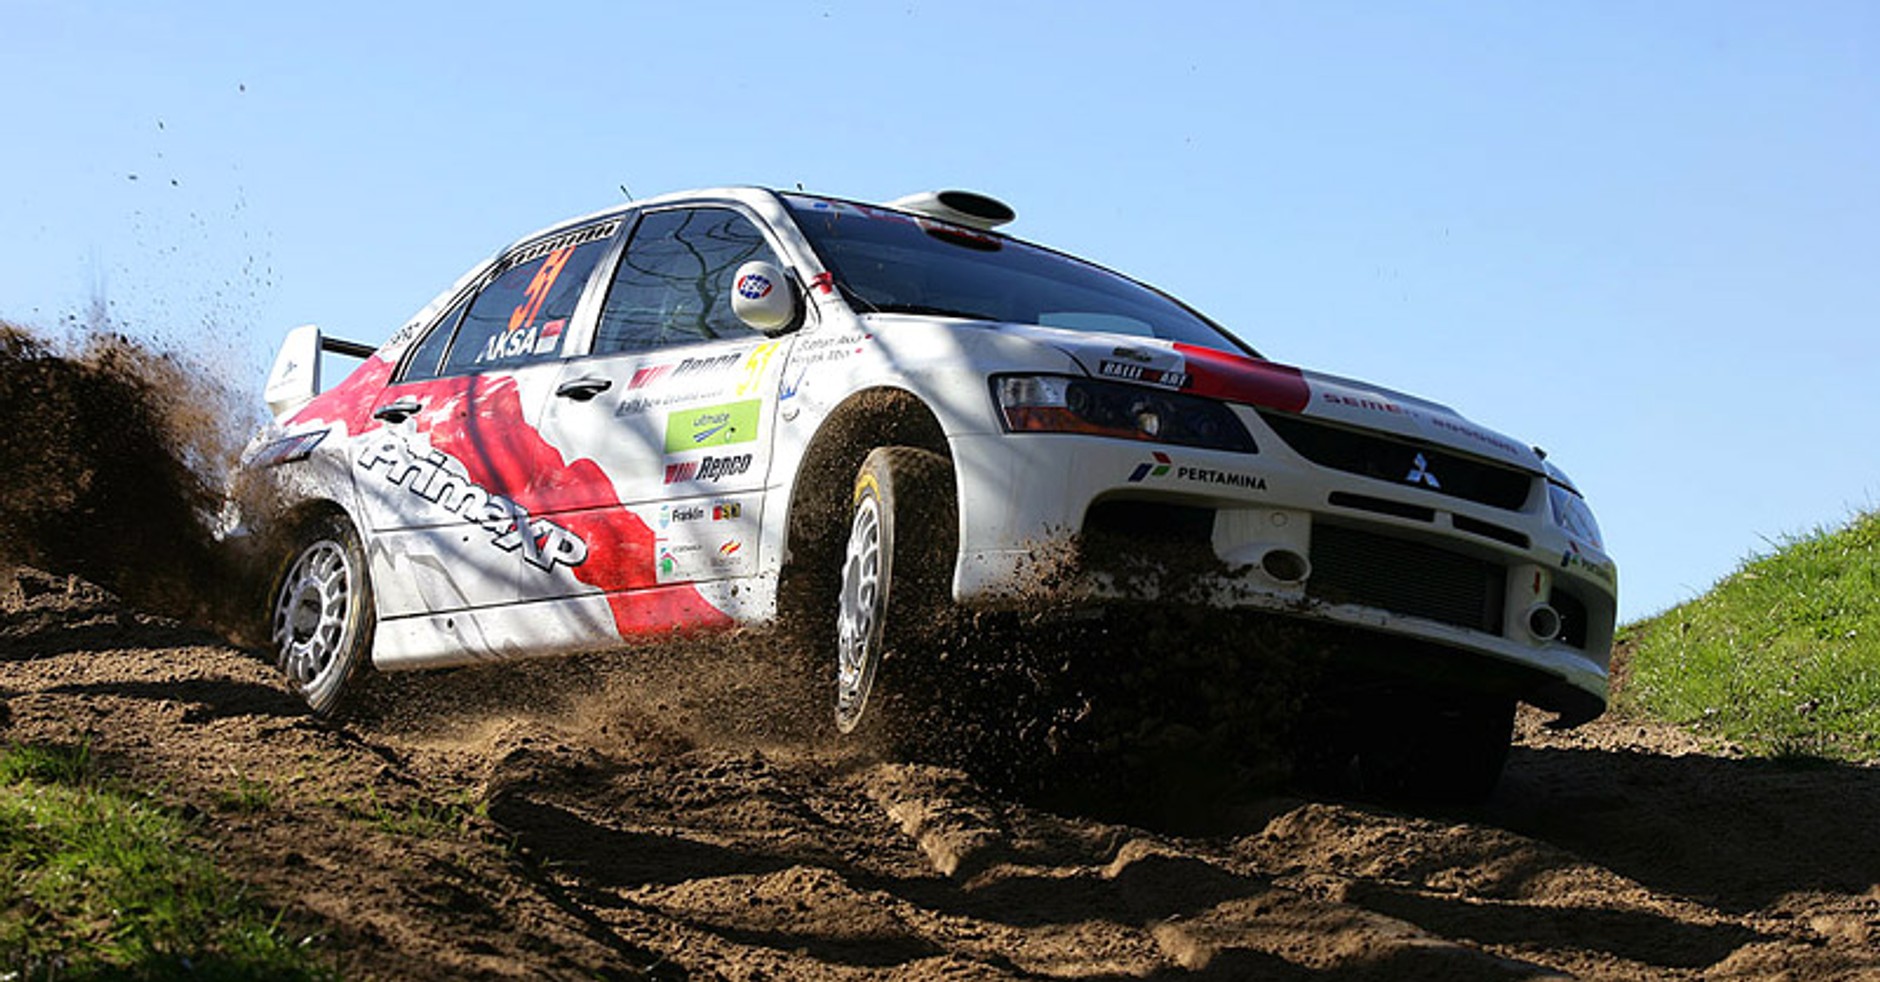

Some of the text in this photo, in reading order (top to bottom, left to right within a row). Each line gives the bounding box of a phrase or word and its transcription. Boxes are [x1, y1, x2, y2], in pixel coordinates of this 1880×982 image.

[508, 244, 577, 332] 51
[474, 327, 538, 363] AKSA
[696, 453, 753, 482] Repco
[1177, 467, 1268, 491] PERTAMINA
[671, 506, 705, 522] Franklin
